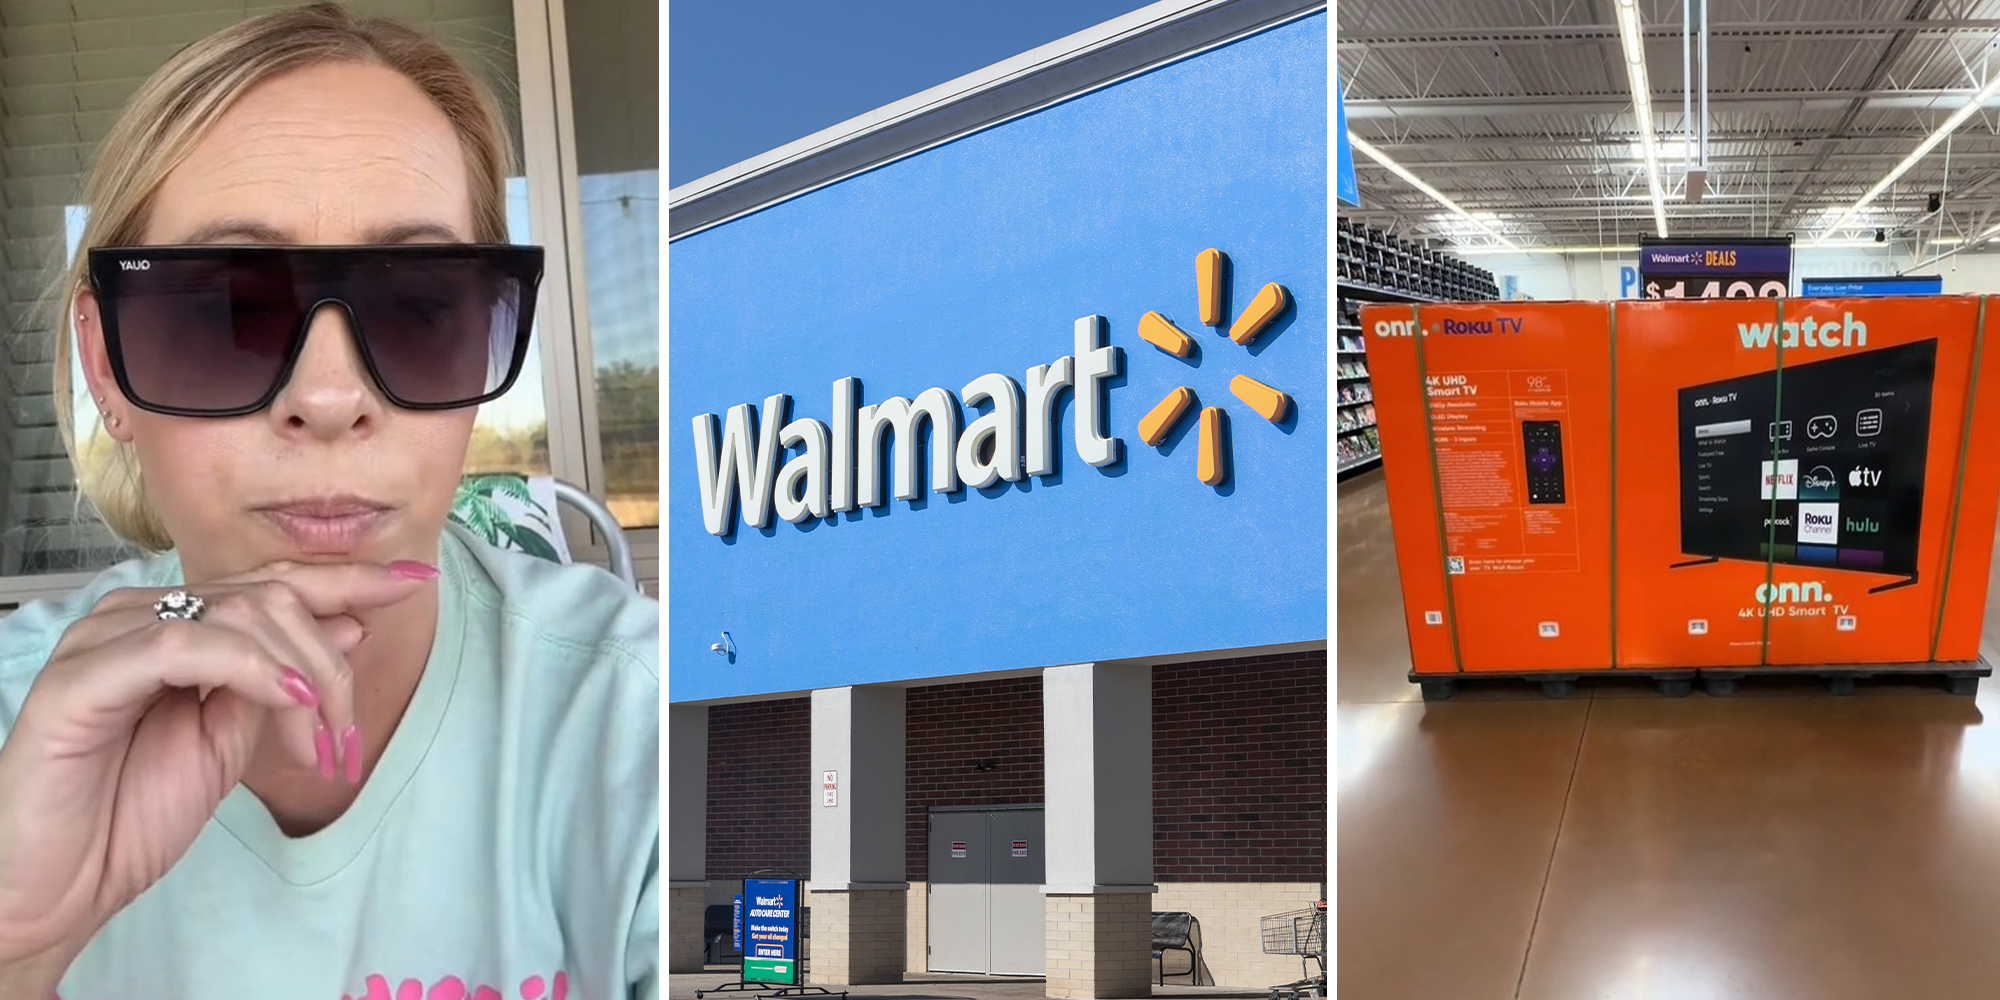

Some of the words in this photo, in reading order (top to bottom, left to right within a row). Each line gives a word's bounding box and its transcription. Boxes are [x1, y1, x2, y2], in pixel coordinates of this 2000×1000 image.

[1651, 253, 1690, 264] Walmart
[1705, 250, 1737, 266] DEALS
[1443, 318, 1493, 335] Roku
[1497, 317, 1523, 334] TV
[1738, 311, 1867, 348] watch
[1426, 375, 1440, 386] 4K
[1442, 375, 1467, 386] UHD
[1427, 386, 1461, 397] Smart
[1462, 386, 1478, 396] TV
[1728, 393, 1738, 402] TV
[692, 314, 1121, 537] Walmart
[1765, 474, 1794, 486] NEFLIX
[1863, 467, 1882, 486] tv
[1763, 516, 1790, 528] pecock
[1804, 512, 1832, 525] Roku
[1804, 525, 1832, 534] Channel
[1846, 518, 1879, 532] hulu
[1755, 581, 1833, 604] onn.
[1738, 607, 1754, 617] 4K
[1788, 606, 1826, 616] Smart
[1833, 605, 1849, 615] TV
[756, 896, 777, 906] Walmart
[750, 909, 761, 917] AUTO
[761, 909, 773, 918] CARE
[773, 909, 790, 918] CENTER
[779, 925, 789, 933] today
[759, 933, 767, 941] your
[773, 933, 788, 942] changed
[758, 948, 770, 956] ENTER
